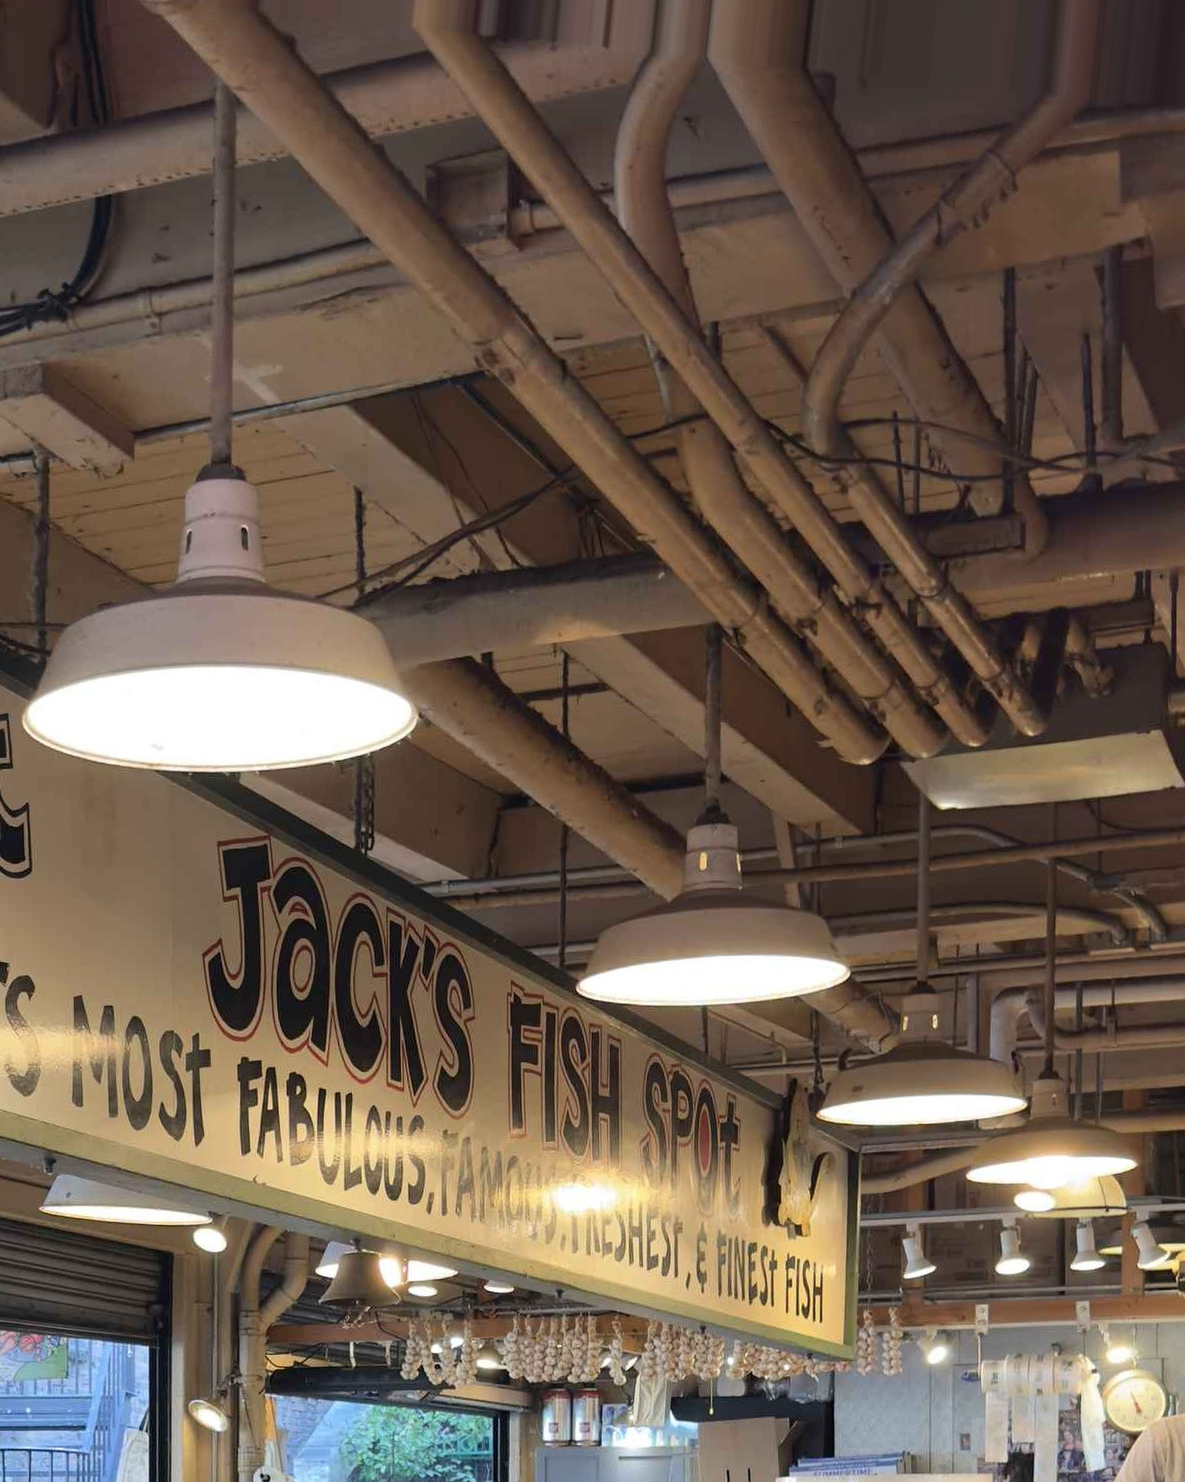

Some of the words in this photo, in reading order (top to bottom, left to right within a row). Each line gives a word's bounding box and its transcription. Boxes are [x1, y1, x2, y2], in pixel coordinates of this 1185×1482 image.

[508, 982, 622, 1169] FISH
[238, 1057, 435, 1222] FABULOUS,
[785, 1254, 825, 1324] FISH
